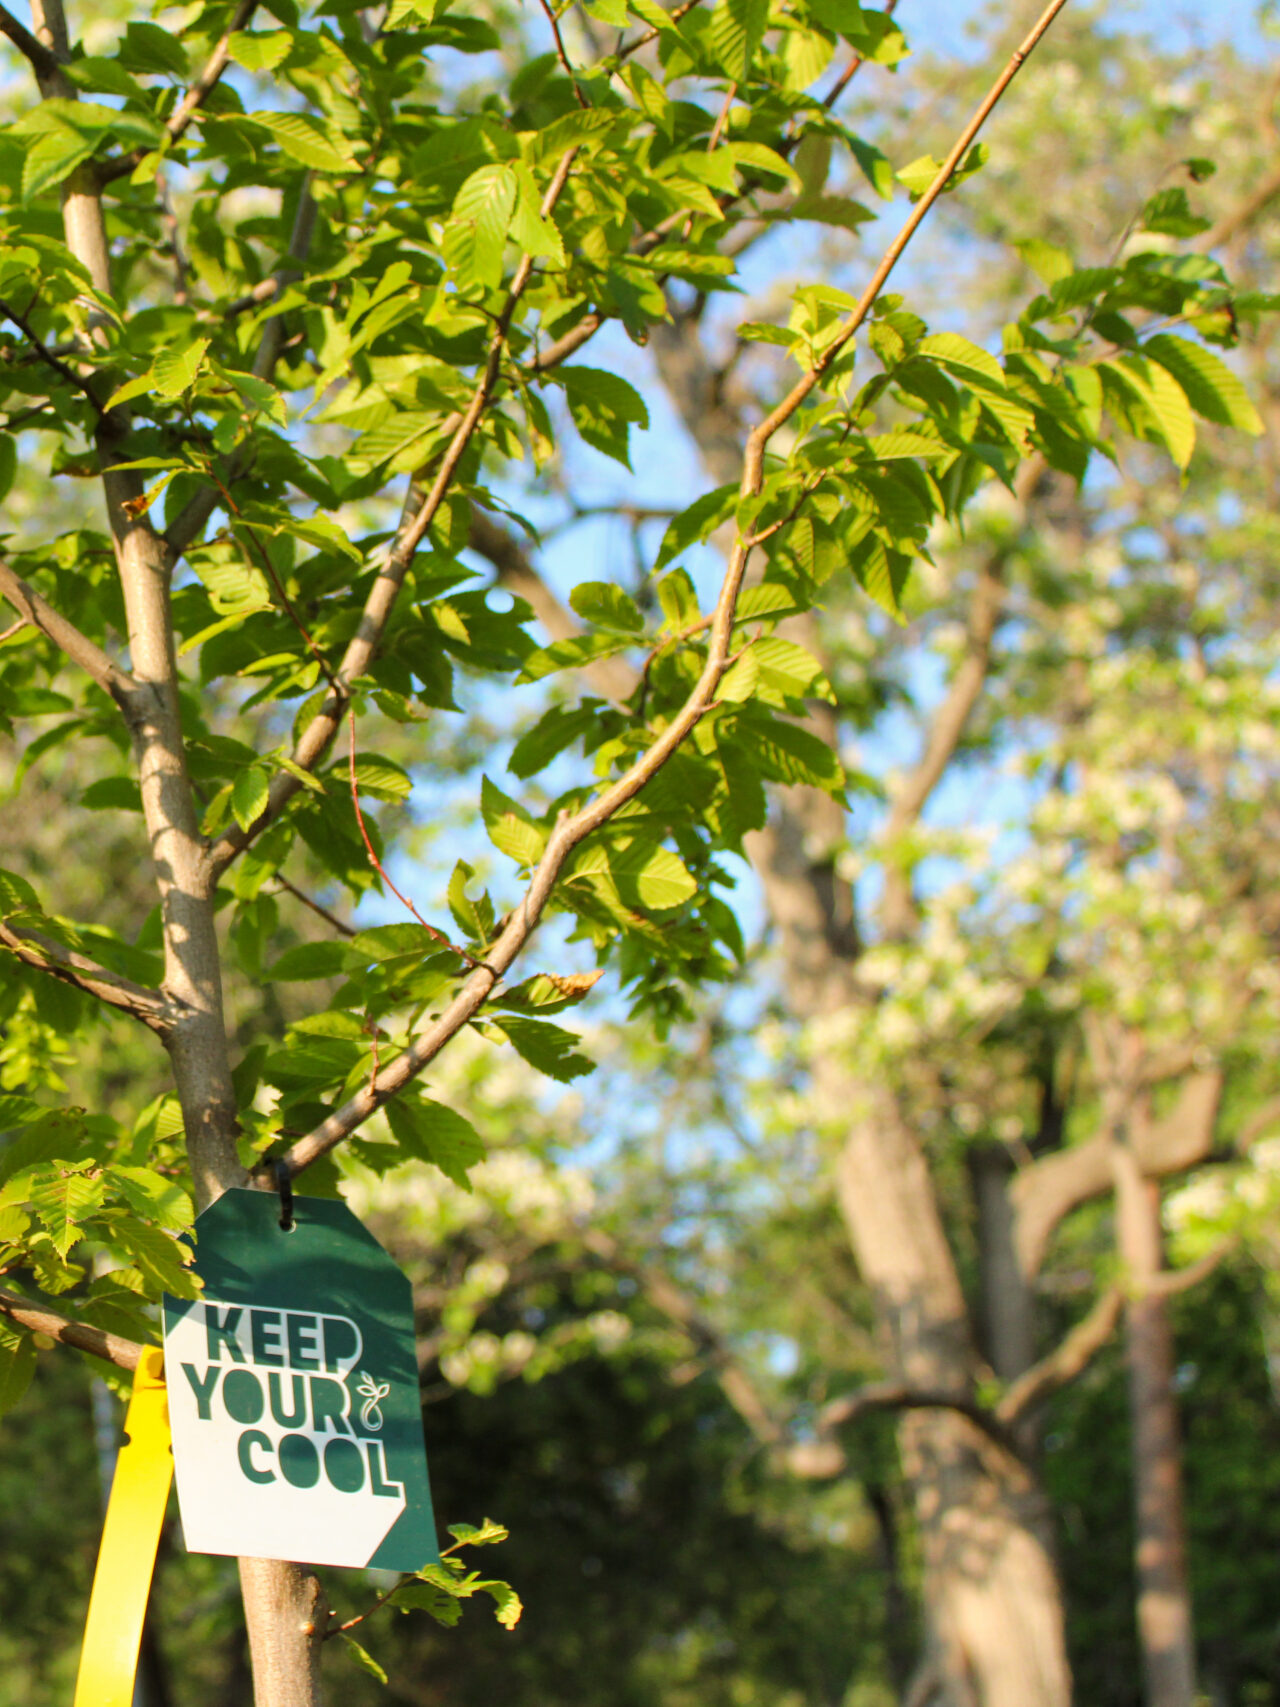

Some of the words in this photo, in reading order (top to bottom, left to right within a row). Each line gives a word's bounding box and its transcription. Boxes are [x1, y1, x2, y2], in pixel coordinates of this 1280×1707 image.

[204, 1303, 358, 1374] KEEP
[180, 1362, 352, 1435] YOUR
[237, 1429, 401, 1498] COOL
